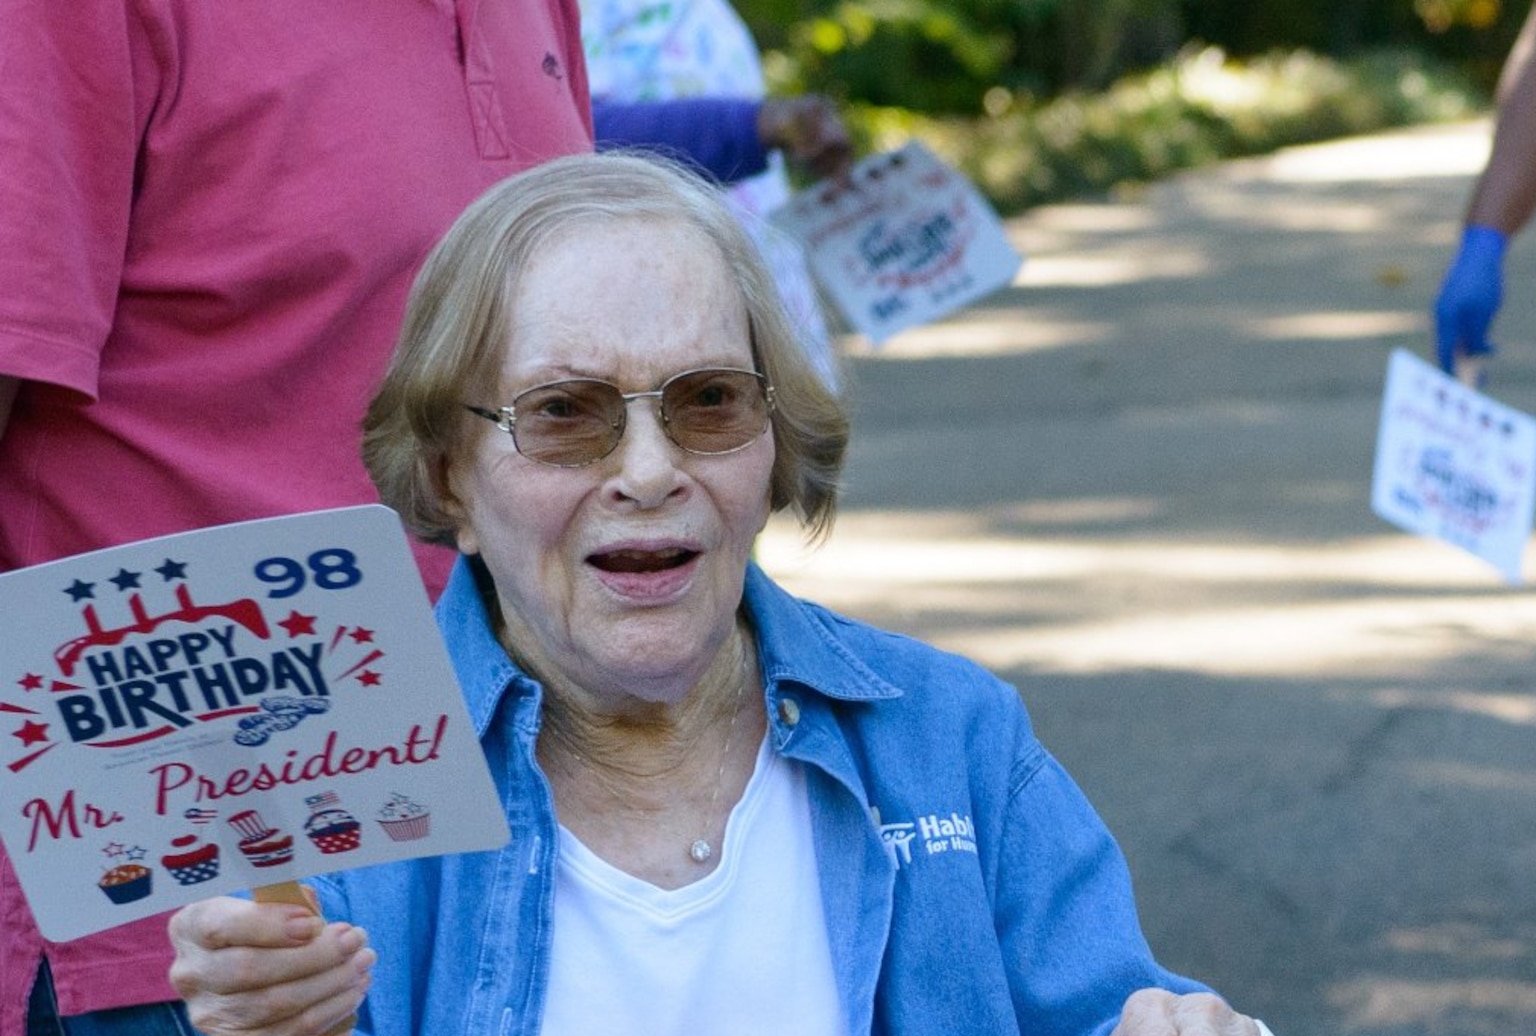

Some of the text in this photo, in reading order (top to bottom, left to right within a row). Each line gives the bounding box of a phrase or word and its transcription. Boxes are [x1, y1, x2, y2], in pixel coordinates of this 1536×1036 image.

[254, 548, 363, 598] 98
[86, 625, 236, 686] HAPPY
[56, 642, 330, 743] BIRTHDAY
[22, 790, 124, 853] Mr.
[149, 714, 448, 815] President!
[926, 840, 949, 855] for
